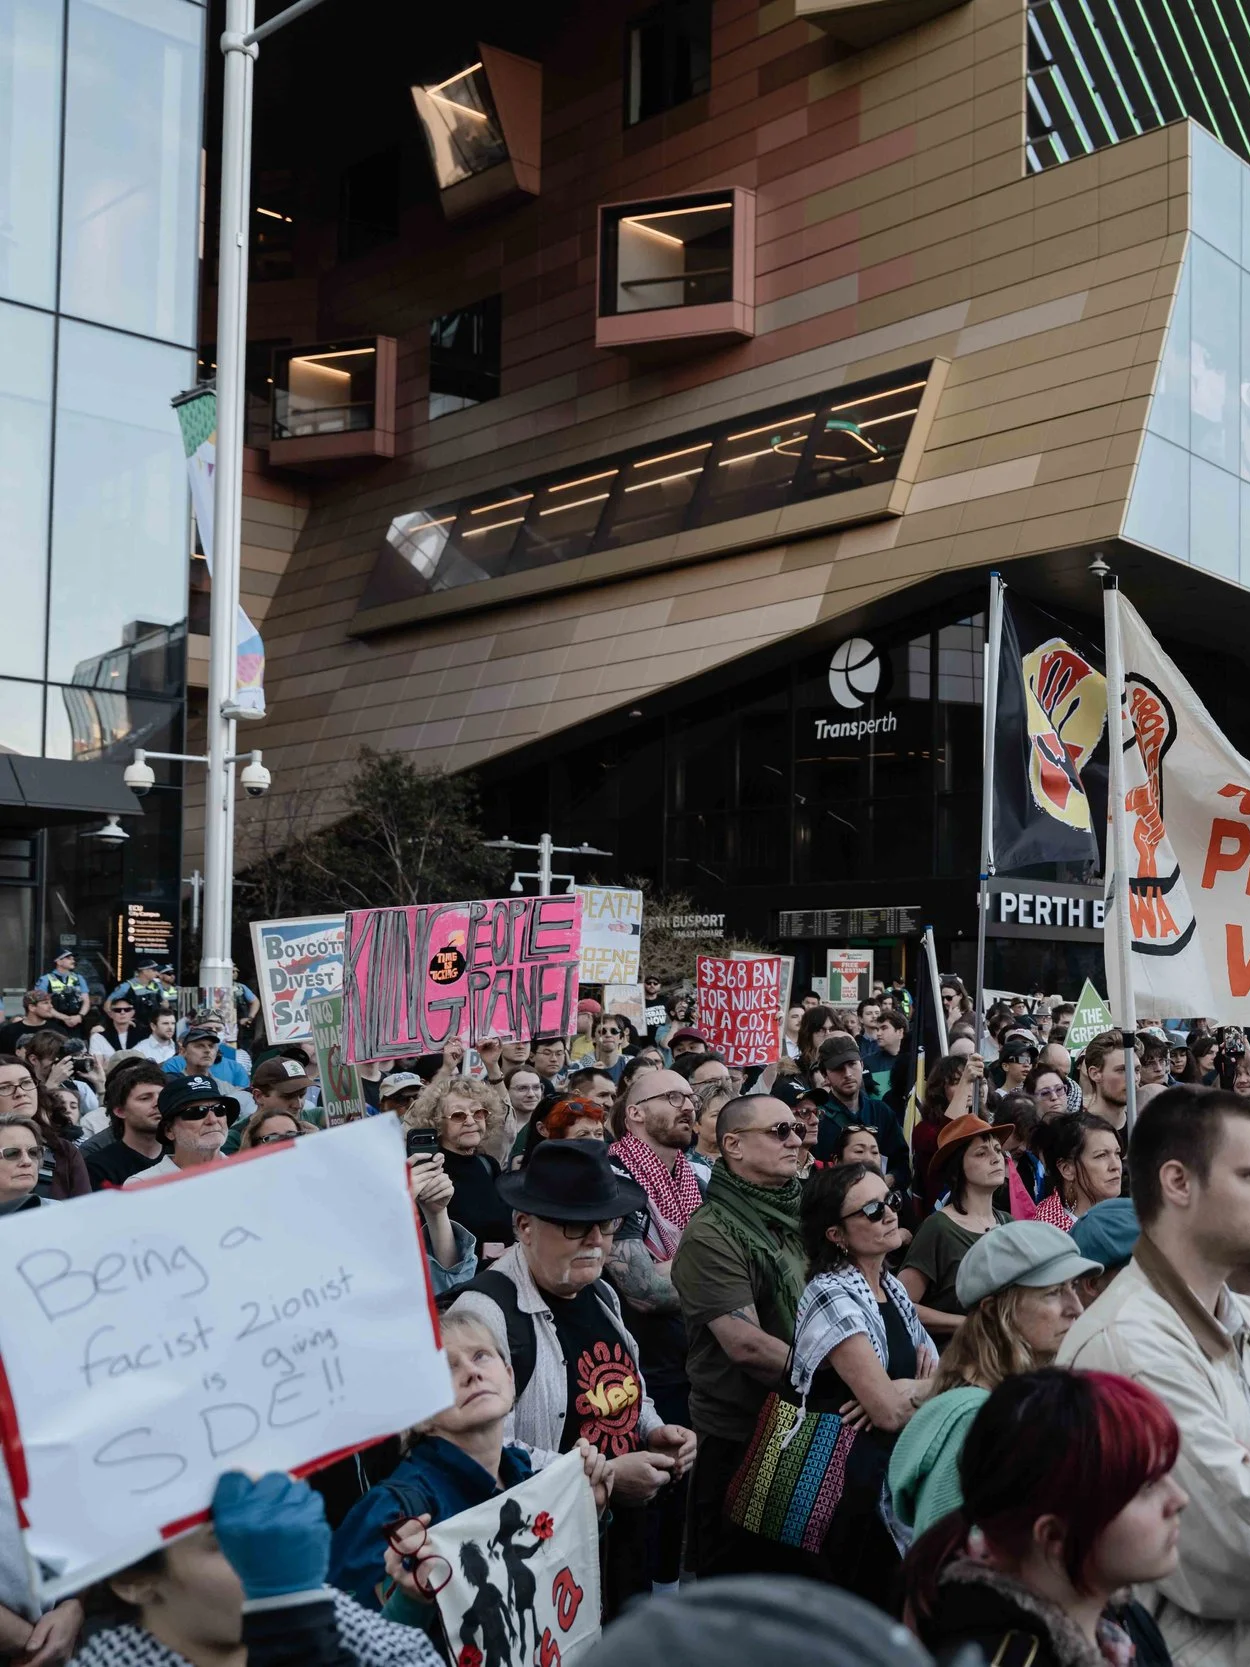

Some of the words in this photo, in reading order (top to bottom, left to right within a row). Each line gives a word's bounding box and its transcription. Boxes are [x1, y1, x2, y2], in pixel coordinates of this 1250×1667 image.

[814, 711, 897, 740] Transperth
[673, 914, 725, 928] BUSPORT
[1001, 892, 1084, 927] PERTH
[1129, 886, 1181, 938] WA
[581, 948, 638, 963] OING
[582, 963, 637, 983] HEAP
[700, 959, 747, 988] $368
[753, 960, 777, 987] BN
[700, 988, 728, 1010] FOR
[731, 987, 777, 1010] NUKES
[702, 1010, 716, 1026] IN
[720, 1013, 732, 1029] A
[736, 1009, 777, 1031] COST
[1080, 1008, 1103, 1024] THE
[723, 1031, 775, 1046] LIVING
[16, 1238, 209, 1322] Being
[219, 1226, 262, 1249] a
[80, 1317, 214, 1388] facist
[203, 1371, 227, 1391] is
[262, 1327, 339, 1376] giving
[585, 1375, 639, 1417] Yes
